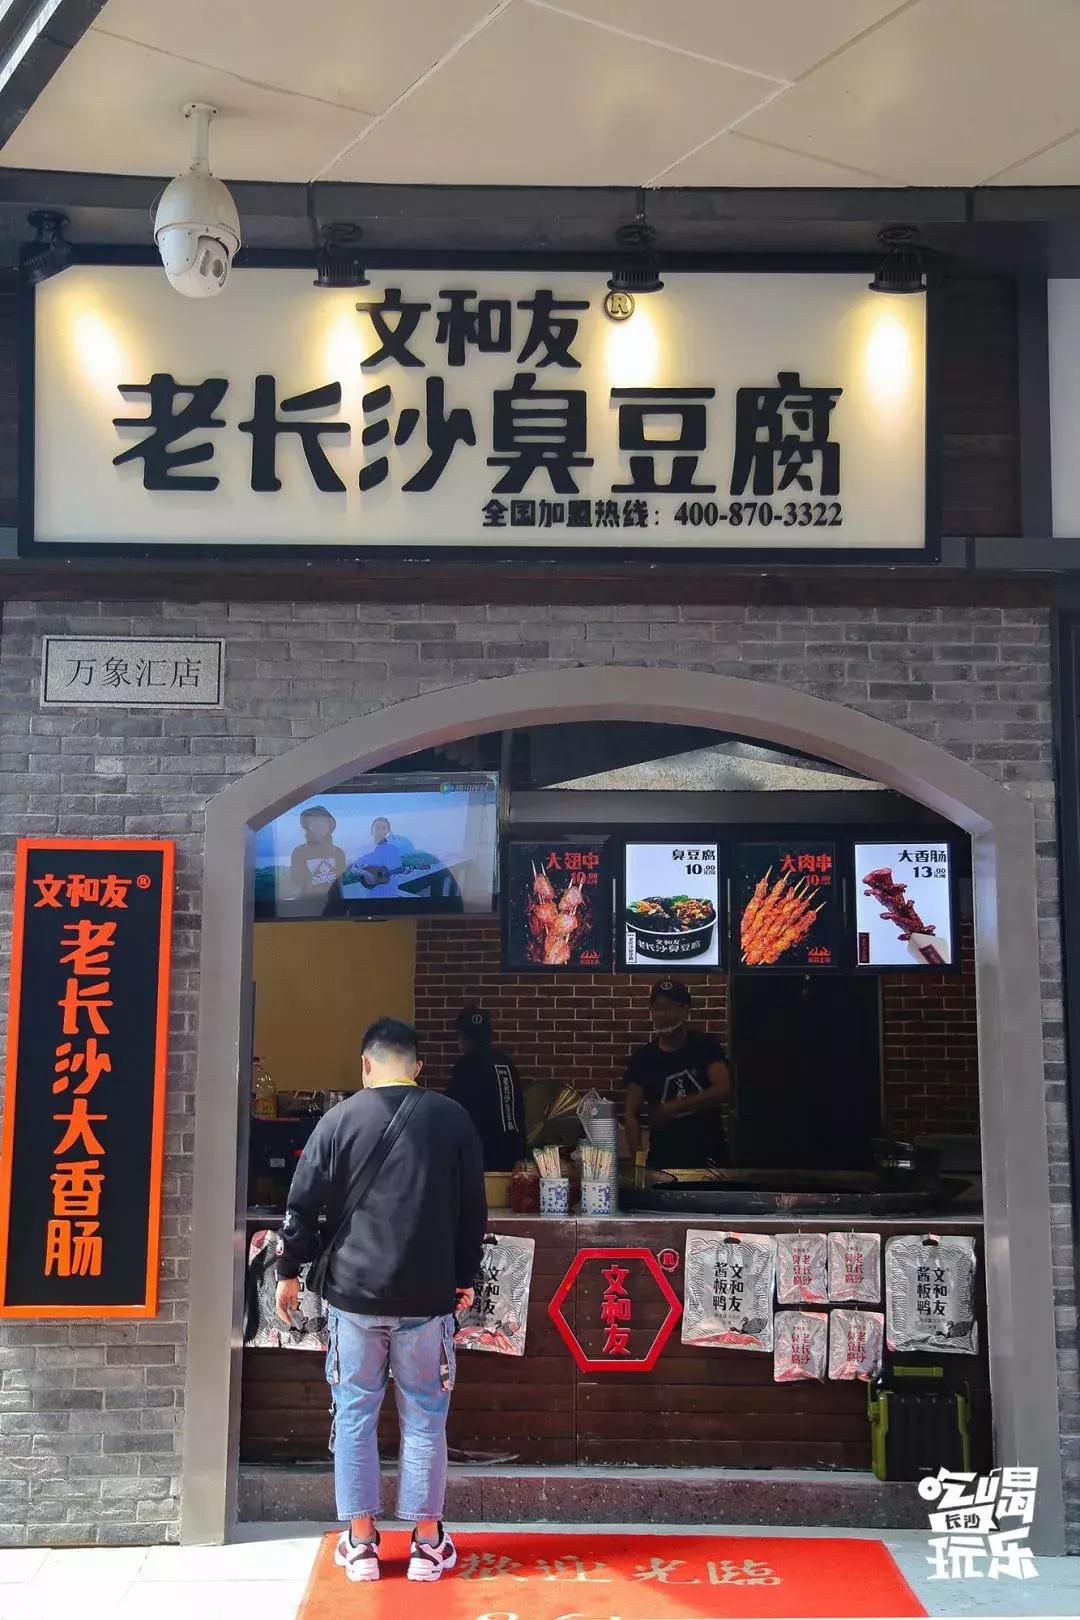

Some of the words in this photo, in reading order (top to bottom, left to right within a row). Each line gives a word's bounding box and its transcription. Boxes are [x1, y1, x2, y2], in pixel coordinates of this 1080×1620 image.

[355, 288, 590, 369] 文和友
[112, 372, 844, 496] 老长沙臭豆腐
[674, 501, 842, 527] 400-870-3322
[66, 656, 202, 689] 万象汇店
[672, 849, 716, 861] 臭豆腐
[780, 853, 833, 873] 大肉串
[898, 849, 947, 863] 大香肠
[32, 873, 132, 909] 文和友
[44, 920, 118, 1277] 老长沙大香肠
[484, 1266, 501, 1315] 文和友
[601, 1264, 631, 1354] 文和友
[713, 1262, 728, 1311] 酱板鸭
[729, 1264, 744, 1312] 文和友
[917, 1266, 931, 1315] 酱板鸭
[932, 1267, 948, 1316] 文和友
